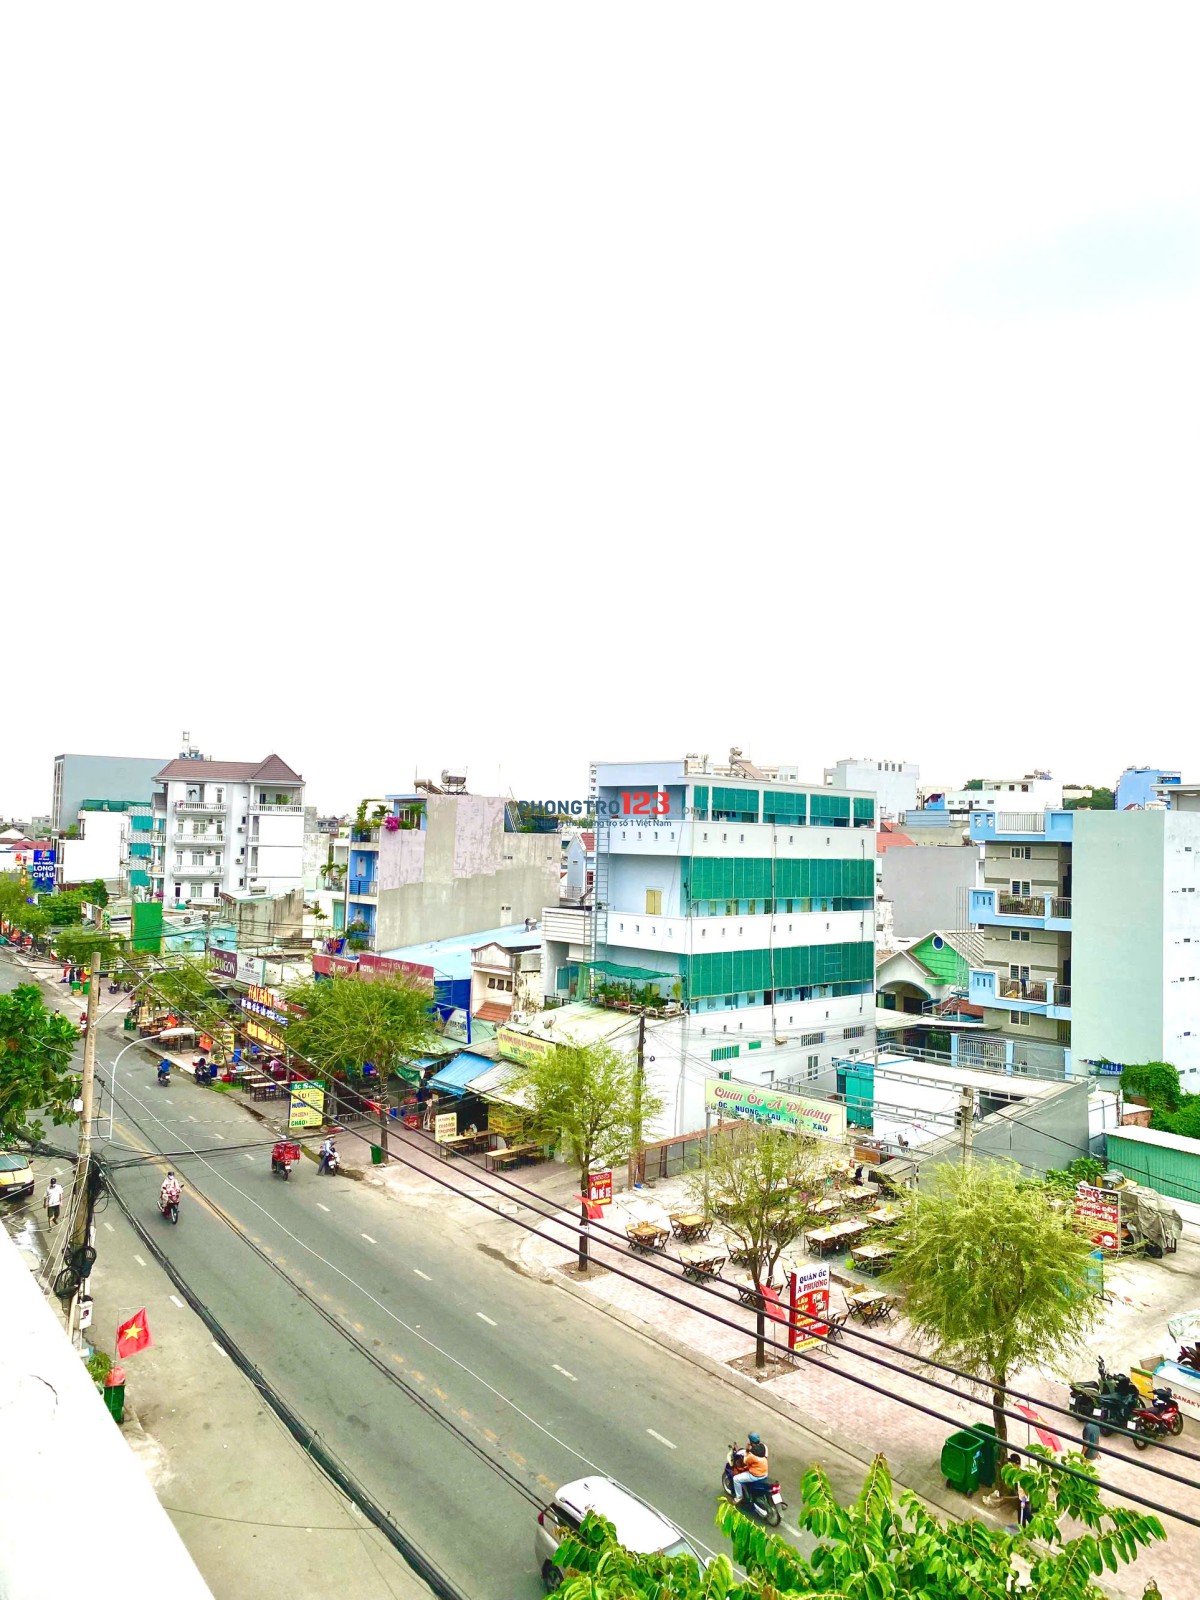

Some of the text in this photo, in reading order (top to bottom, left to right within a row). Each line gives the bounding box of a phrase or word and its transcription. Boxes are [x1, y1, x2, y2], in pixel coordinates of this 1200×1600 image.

[799, 1268, 827, 1284] QUÁN ỐC
[803, 1278, 828, 1292] PHƯƠNG
